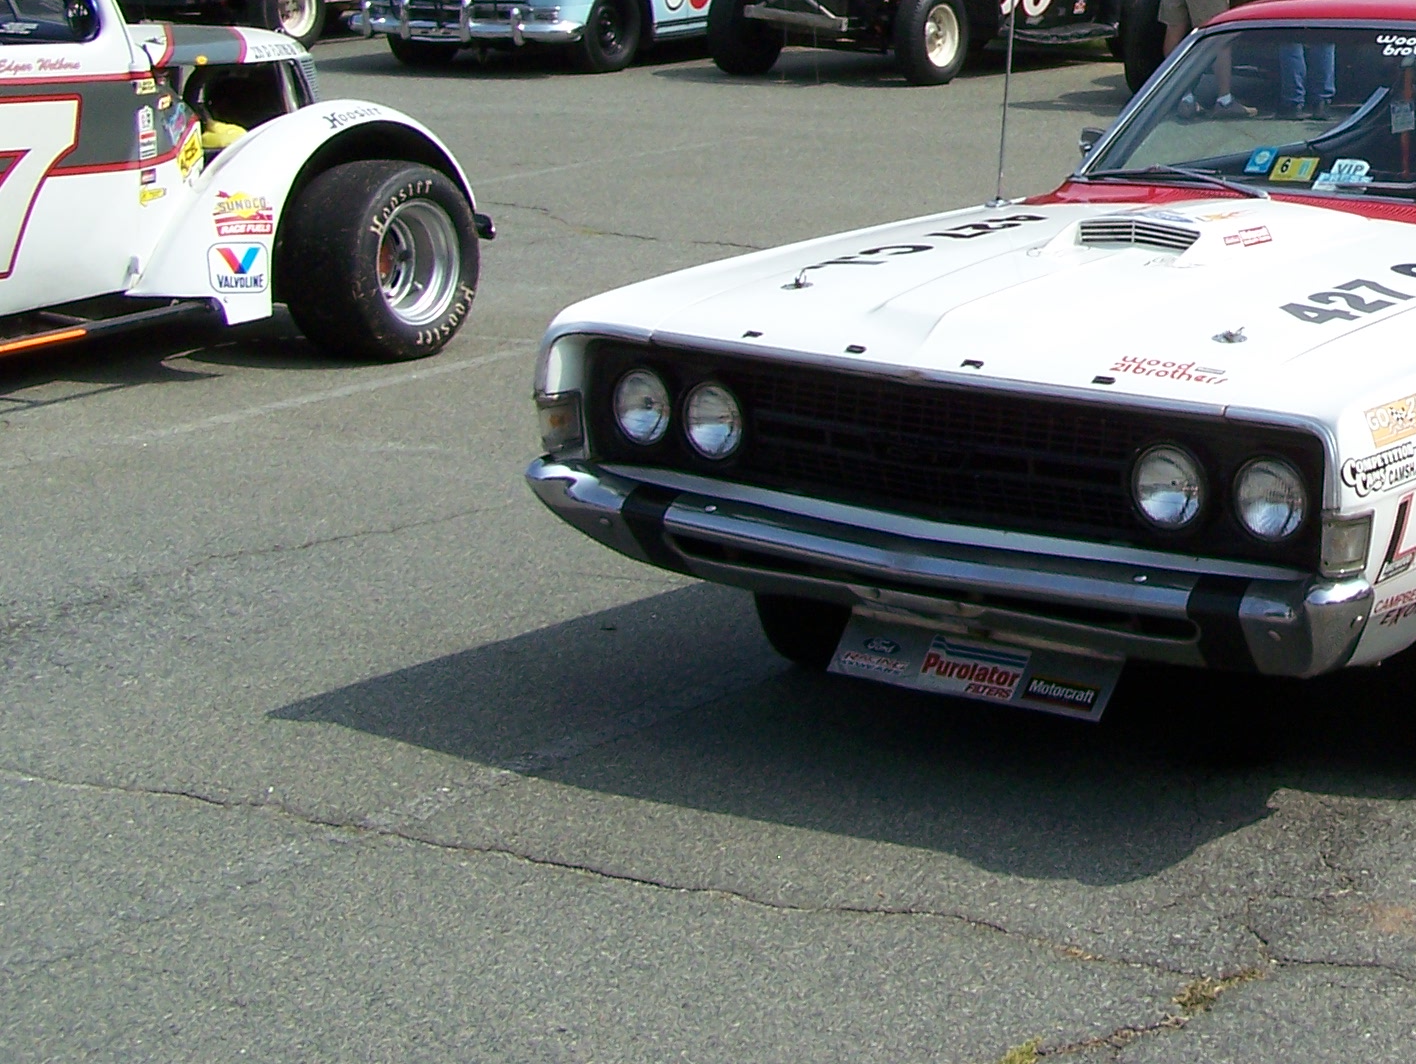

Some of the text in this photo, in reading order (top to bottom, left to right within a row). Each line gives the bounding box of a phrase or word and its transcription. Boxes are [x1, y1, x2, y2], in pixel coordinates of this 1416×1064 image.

[322, 107, 384, 129] Hoosier
[1280, 158, 1292, 173] 6
[1337, 163, 1366, 174] VIP
[0, 94, 83, 279] 7
[216, 195, 268, 213] SUNOCO
[369, 179, 433, 238] Hoosier
[221, 222, 272, 235] RACE FUELS
[216, 272, 265, 289] VALVOLINE
[1279, 278, 1416, 324] 427
[416, 281, 475, 345] Hoosier
[1341, 442, 1415, 488] COMPETITION
[865, 638, 896, 653] Ford
[920, 653, 1021, 687] Purolator
[964, 682, 1013, 699] FILTERS
[1028, 678, 1097, 705] Motorcraft
